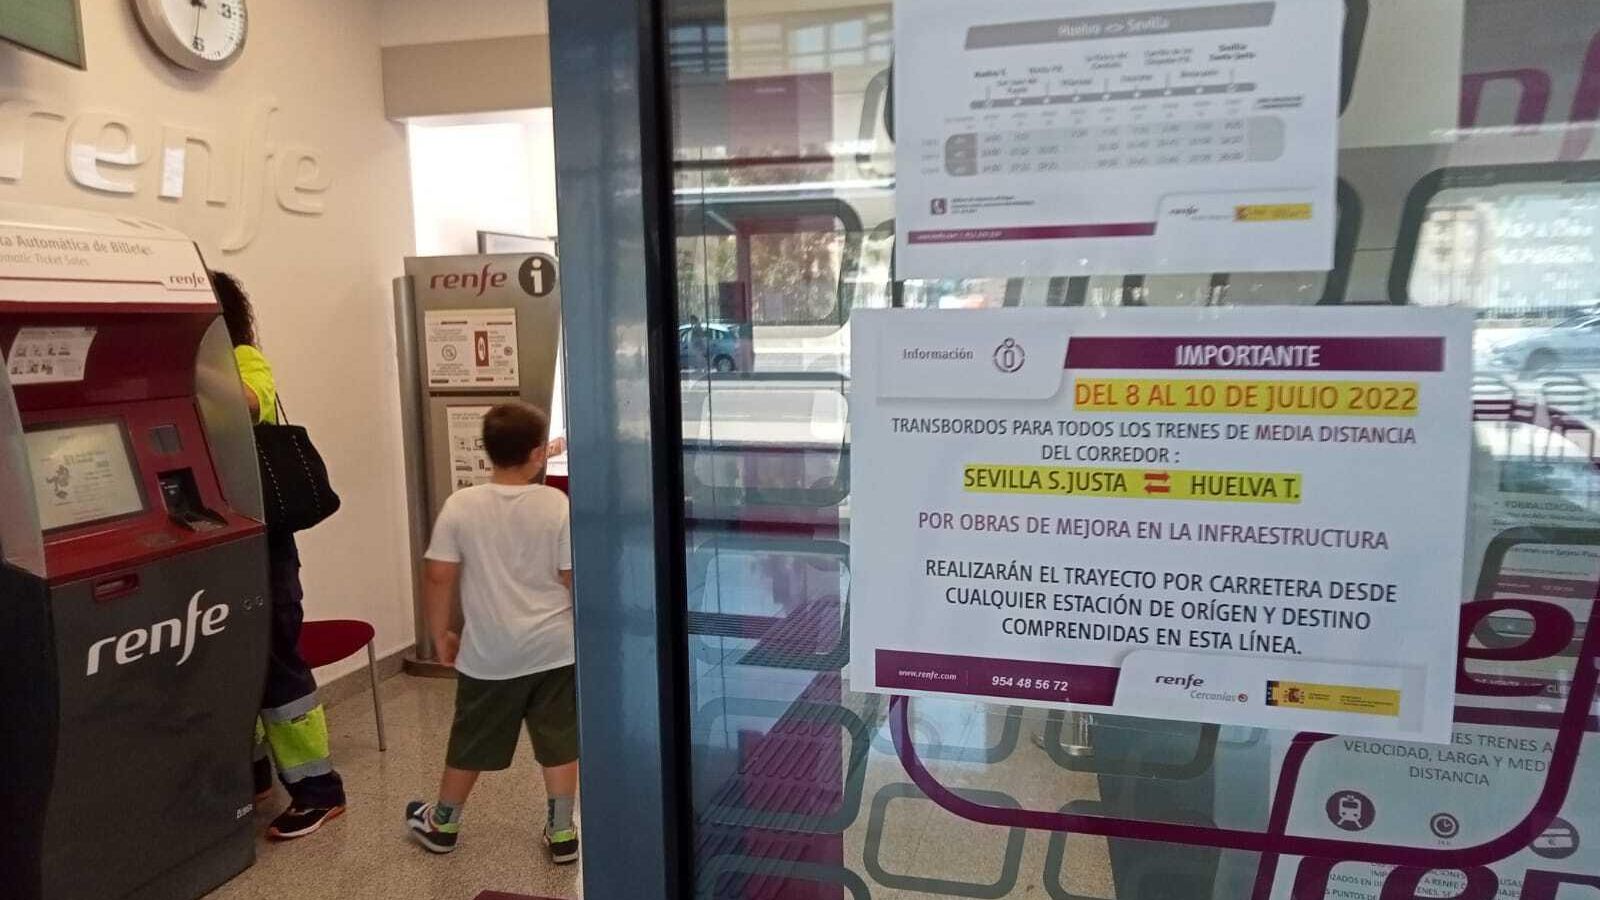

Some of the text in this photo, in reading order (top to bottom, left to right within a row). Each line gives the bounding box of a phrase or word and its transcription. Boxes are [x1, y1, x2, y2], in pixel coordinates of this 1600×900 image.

[222, 3, 232, 18] 3
[16, 235, 90, 252] Automática
[93, 239, 107, 251] de
[169, 272, 206, 289] renfe
[429, 262, 508, 297] renfe
[903, 347, 974, 360] Información
[1175, 344, 1321, 368] IMPORTANTE
[1075, 383, 1418, 412] DEL 8 AL 10 DE JULIO 2022
[892, 417, 1417, 444] TRANSBORDOS PARA TODOS LOS TRENES DE MEDIA DISTANCIA
[1042, 444, 1072, 460] DEL
[1076, 445, 1169, 463] CORREDOR
[964, 468, 1300, 498] SEVILLA S.JUSTA HUELVA T.
[919, 511, 1389, 550] POR OBRAS DE MEJORA EN LA INFRAESTRUCTURA
[926, 559, 1397, 603] REALIZARÁN EL TRAYECTO POR CARRETERA DESDE
[946, 586, 1371, 630] CUALQUIER ESTACIÓN DE ORÍGEN Y DESTINO
[86, 589, 230, 677] renfe
[1002, 617, 1302, 655] COMPRENDIDAS EN ESTA LÍNEA.
[898, 668, 1069, 691] www.renfe.com 954 48 56 72
[1155, 673, 1204, 689] renfe
[1190, 689, 1235, 702] Cercanías
[1478, 734, 1537, 752] TRENES
[1343, 739, 1549, 772] VELOCIDAD, LARGA Y MED
[1409, 765, 1490, 786] DISTANCIA
